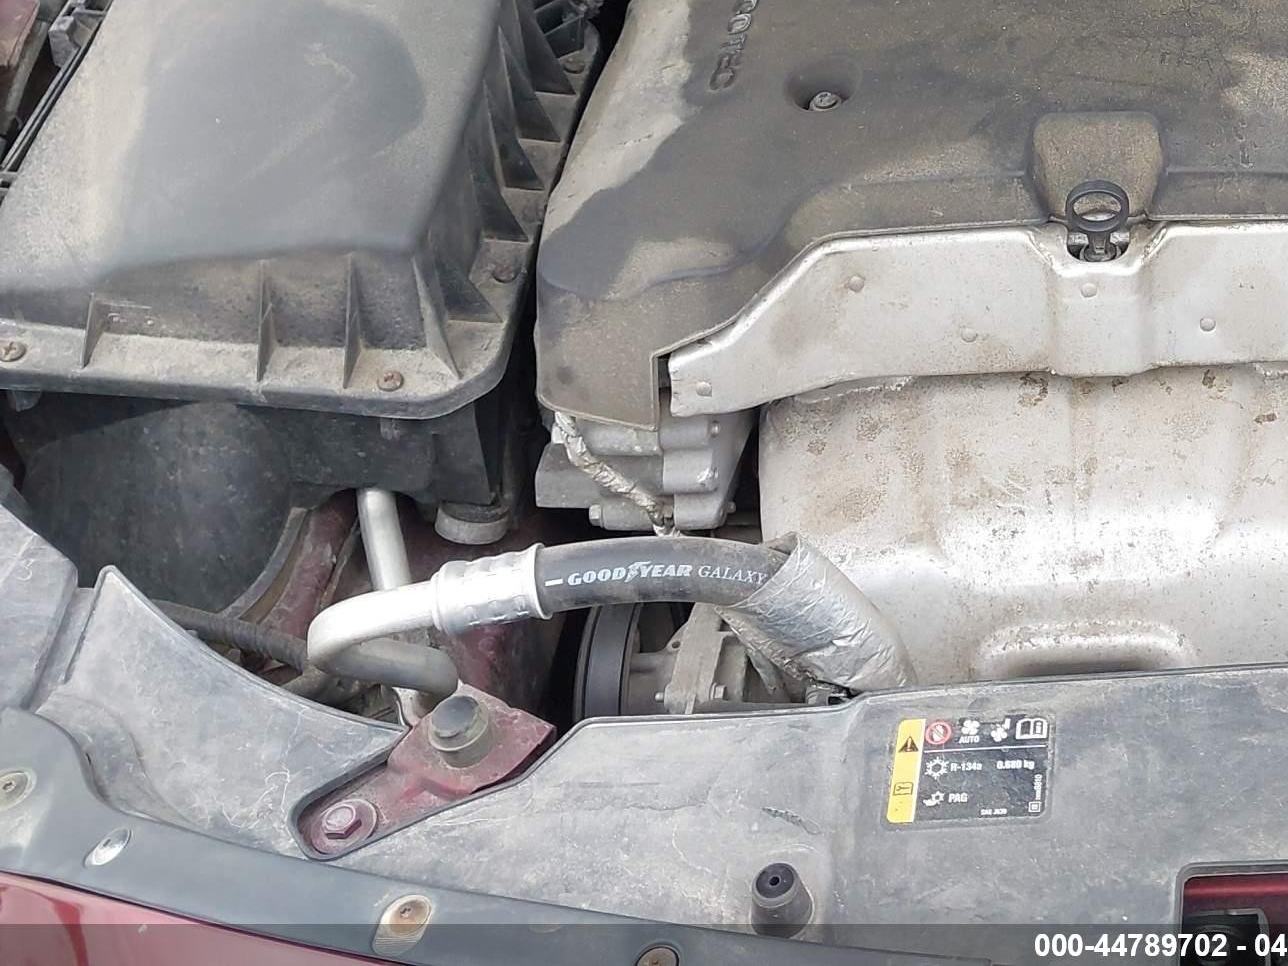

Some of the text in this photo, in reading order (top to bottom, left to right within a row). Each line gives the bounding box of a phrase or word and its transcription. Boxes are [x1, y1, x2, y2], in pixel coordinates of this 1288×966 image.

[567, 561, 768, 586] GOODYEAR GALAXY
[958, 735, 980, 744] AUTO
[950, 762, 983, 772] R-134a
[1023, 759, 1035, 771] kg
[948, 793, 968, 803] PAG
